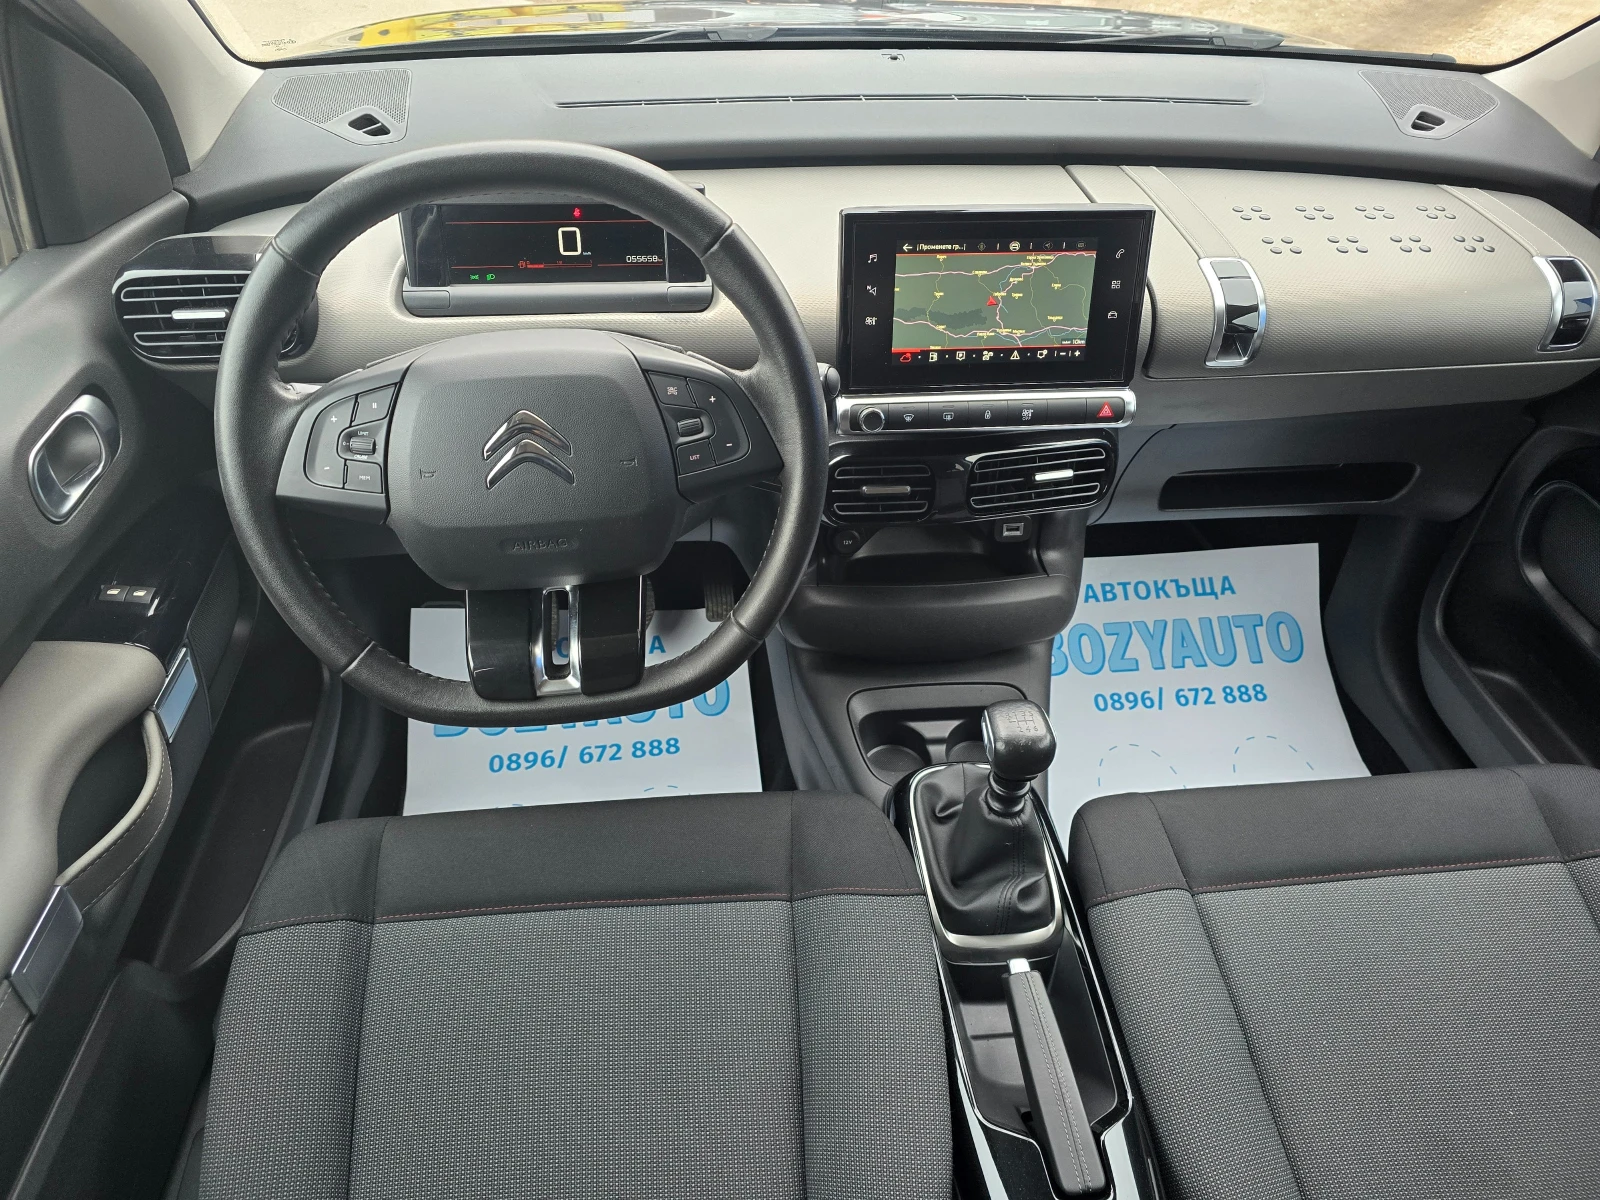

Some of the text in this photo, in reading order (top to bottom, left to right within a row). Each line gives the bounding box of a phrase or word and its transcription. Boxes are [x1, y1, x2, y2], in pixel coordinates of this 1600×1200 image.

[557, 227, 582, 256] 0
[513, 538, 569, 551] AIRBAG
[1083, 575, 1237, 604] АВТОКЪЩА
[1094, 683, 1269, 712] 0896/ 672 888
[489, 736, 681, 774] 0896/ 672 888
